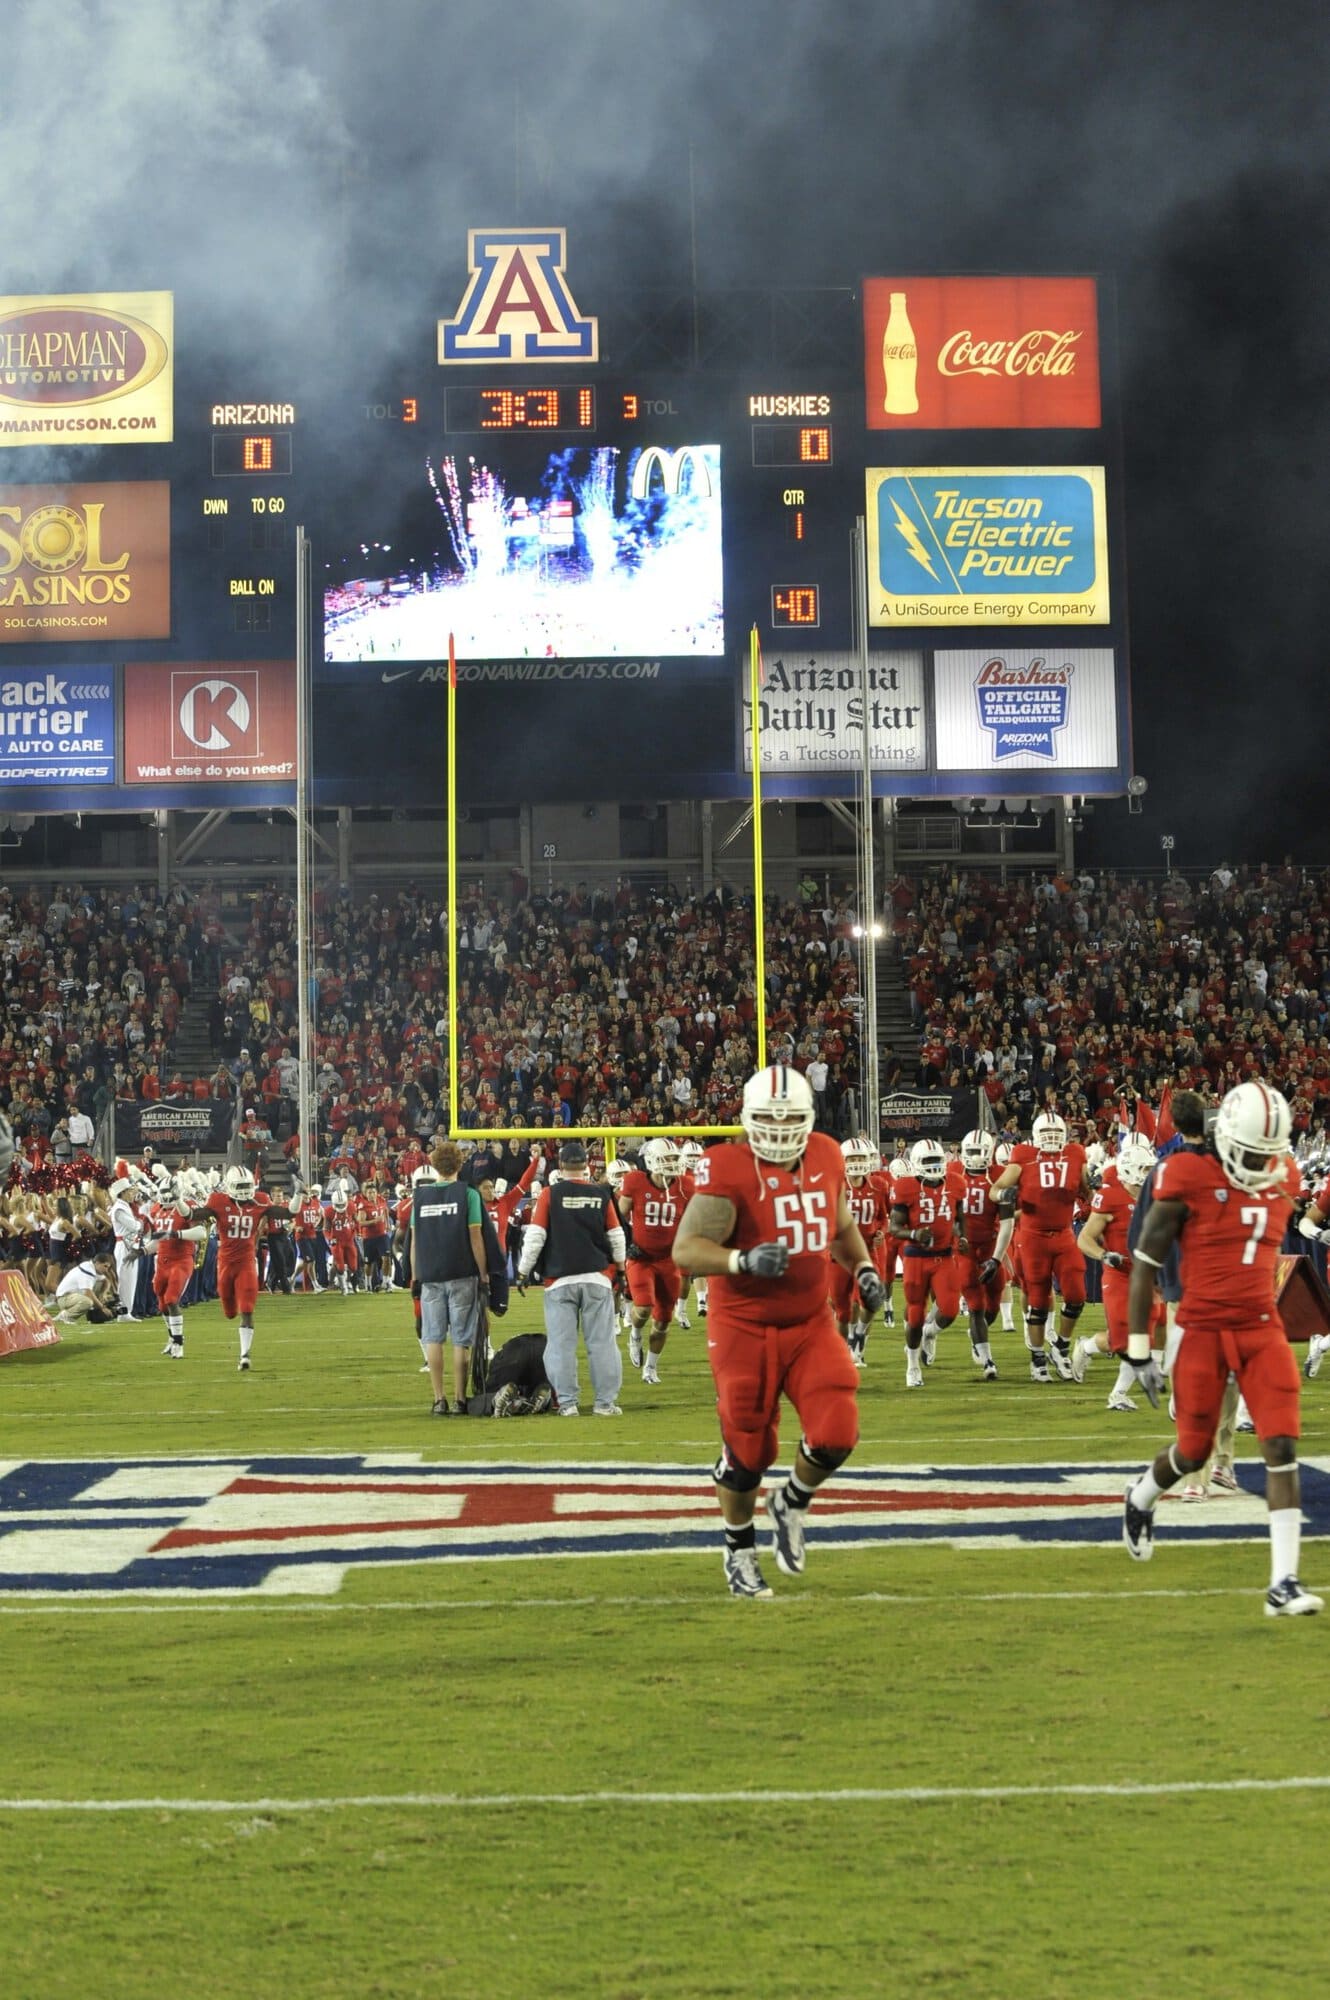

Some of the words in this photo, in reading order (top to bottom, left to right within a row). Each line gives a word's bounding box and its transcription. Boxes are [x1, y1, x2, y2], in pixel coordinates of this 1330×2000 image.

[437, 227, 599, 365] A
[937, 330, 1083, 376] Coca-Cola
[0, 369, 125, 385] UTOMOTIVE
[212, 404, 295, 425] ARIZONA
[362, 404, 397, 420] TOL
[402, 398, 417, 422] 3
[481, 389, 591, 427] 3:31
[622, 395, 638, 419] 3
[644, 399, 678, 415] TOL
[749, 396, 831, 417] HUSKIES
[0, 417, 157, 433] MANTUCSON.COM
[801, 428, 829, 461] 0
[243, 437, 272, 470] 0
[783, 489, 805, 505] QTR
[933, 490, 1043, 519] Tucson
[203, 499, 228, 515] DWN
[251, 498, 266, 514] TO
[268, 498, 285, 513] GO
[796, 512, 803, 540] 1
[945, 520, 1074, 547] Electric
[959, 550, 1074, 577] Power
[230, 580, 256, 595] BALL
[258, 579, 275, 595] ON
[775, 590, 815, 622] 40
[879, 603, 891, 616] A
[895, 602, 969, 616] UniSource
[974, 602, 1023, 618] Energy
[1028, 601, 1096, 618] Company
[4, 616, 108, 628] SOLCASINOS.COM
[418, 662, 660, 683] ARZONAWILDCATS.COM
[984, 690, 1061, 702] OFFICIAL
[984, 703, 1061, 715] TAILGATE
[742, 698, 836, 739] Daily
[846, 697, 921, 731] Star
[985, 715, 1061, 724] HEADQUARTERS
[7, 740, 54, 753] AUTO
[58, 739, 104, 753] CARE
[998, 733, 1049, 743] ARIZONA
[779, 750, 790, 761] a
[796, 745, 862, 761] Tucson
[137, 766, 171, 777] What
[175, 765, 202, 776] else
[205, 765, 222, 776] do
[226, 766, 249, 778] you
[252, 762, 293, 775] need?
[1162, 835, 1175, 849] 29
[543, 844, 557, 858] 28
[882, 1100, 921, 1108] AMERICAN
[923, 1099, 951, 1107] FAMILY
[183, 1112, 210, 1120] FAMILY
[1039, 1161, 1068, 1188] 67
[420, 1202, 458, 1218] ESPN
[562, 1196, 602, 1209] ESPN
[919, 1195, 952, 1224] 34
[645, 1201, 677, 1228] 90
[773, 1191, 828, 1255] 55
[227, 1215, 254, 1239] 39
[1240, 1206, 1269, 1265] 7
